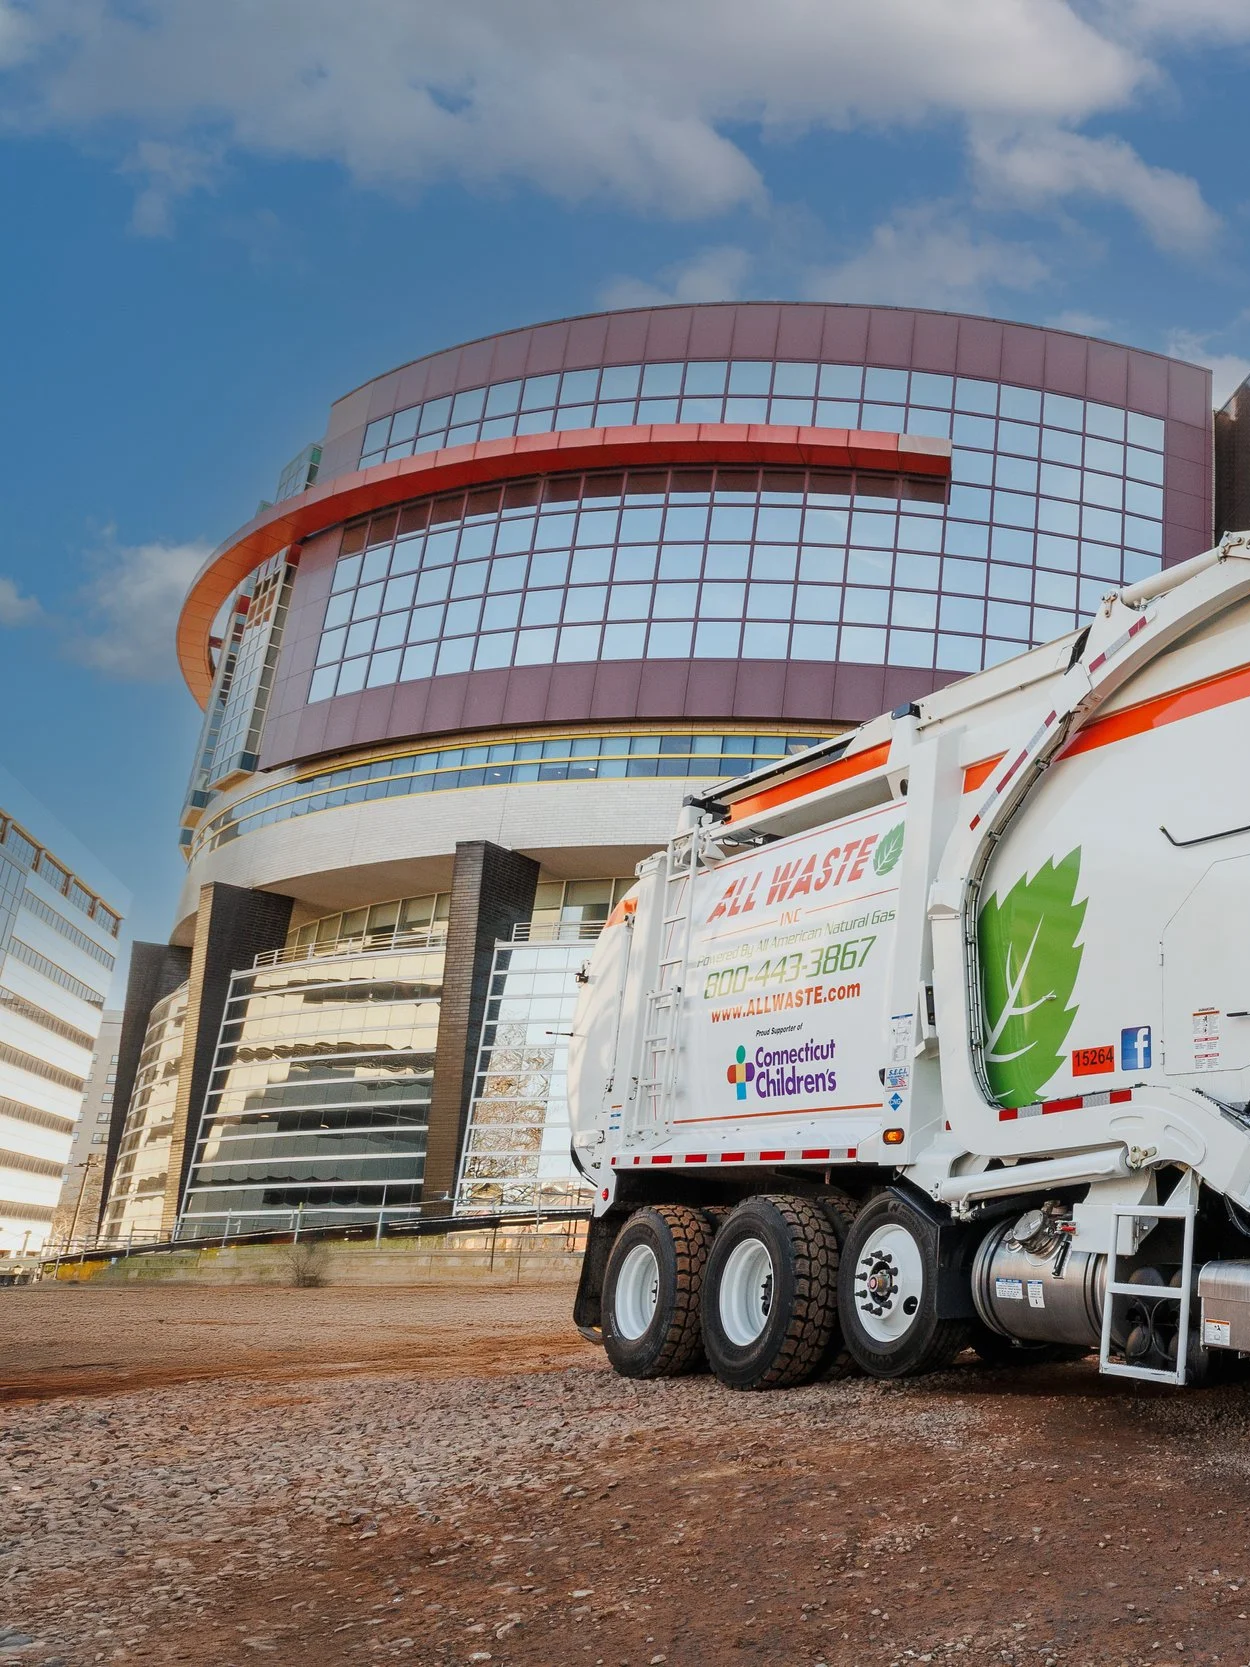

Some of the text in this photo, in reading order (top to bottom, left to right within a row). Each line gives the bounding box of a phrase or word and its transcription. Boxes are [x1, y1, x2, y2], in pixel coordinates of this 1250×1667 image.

[706, 834, 879, 924] ALL WASTE
[780, 908, 802, 926] INC
[697, 909, 896, 968] Powered By All American Natural Gas
[704, 935, 877, 999] 800-443-3867
[711, 983, 861, 1023] www.ALLWASTE.com
[756, 1022, 803, 1037] Proud Supporter of
[755, 1038, 836, 1068] Connecticut
[1074, 1048, 1114, 1068] 15264
[755, 1065, 837, 1099] Children's
